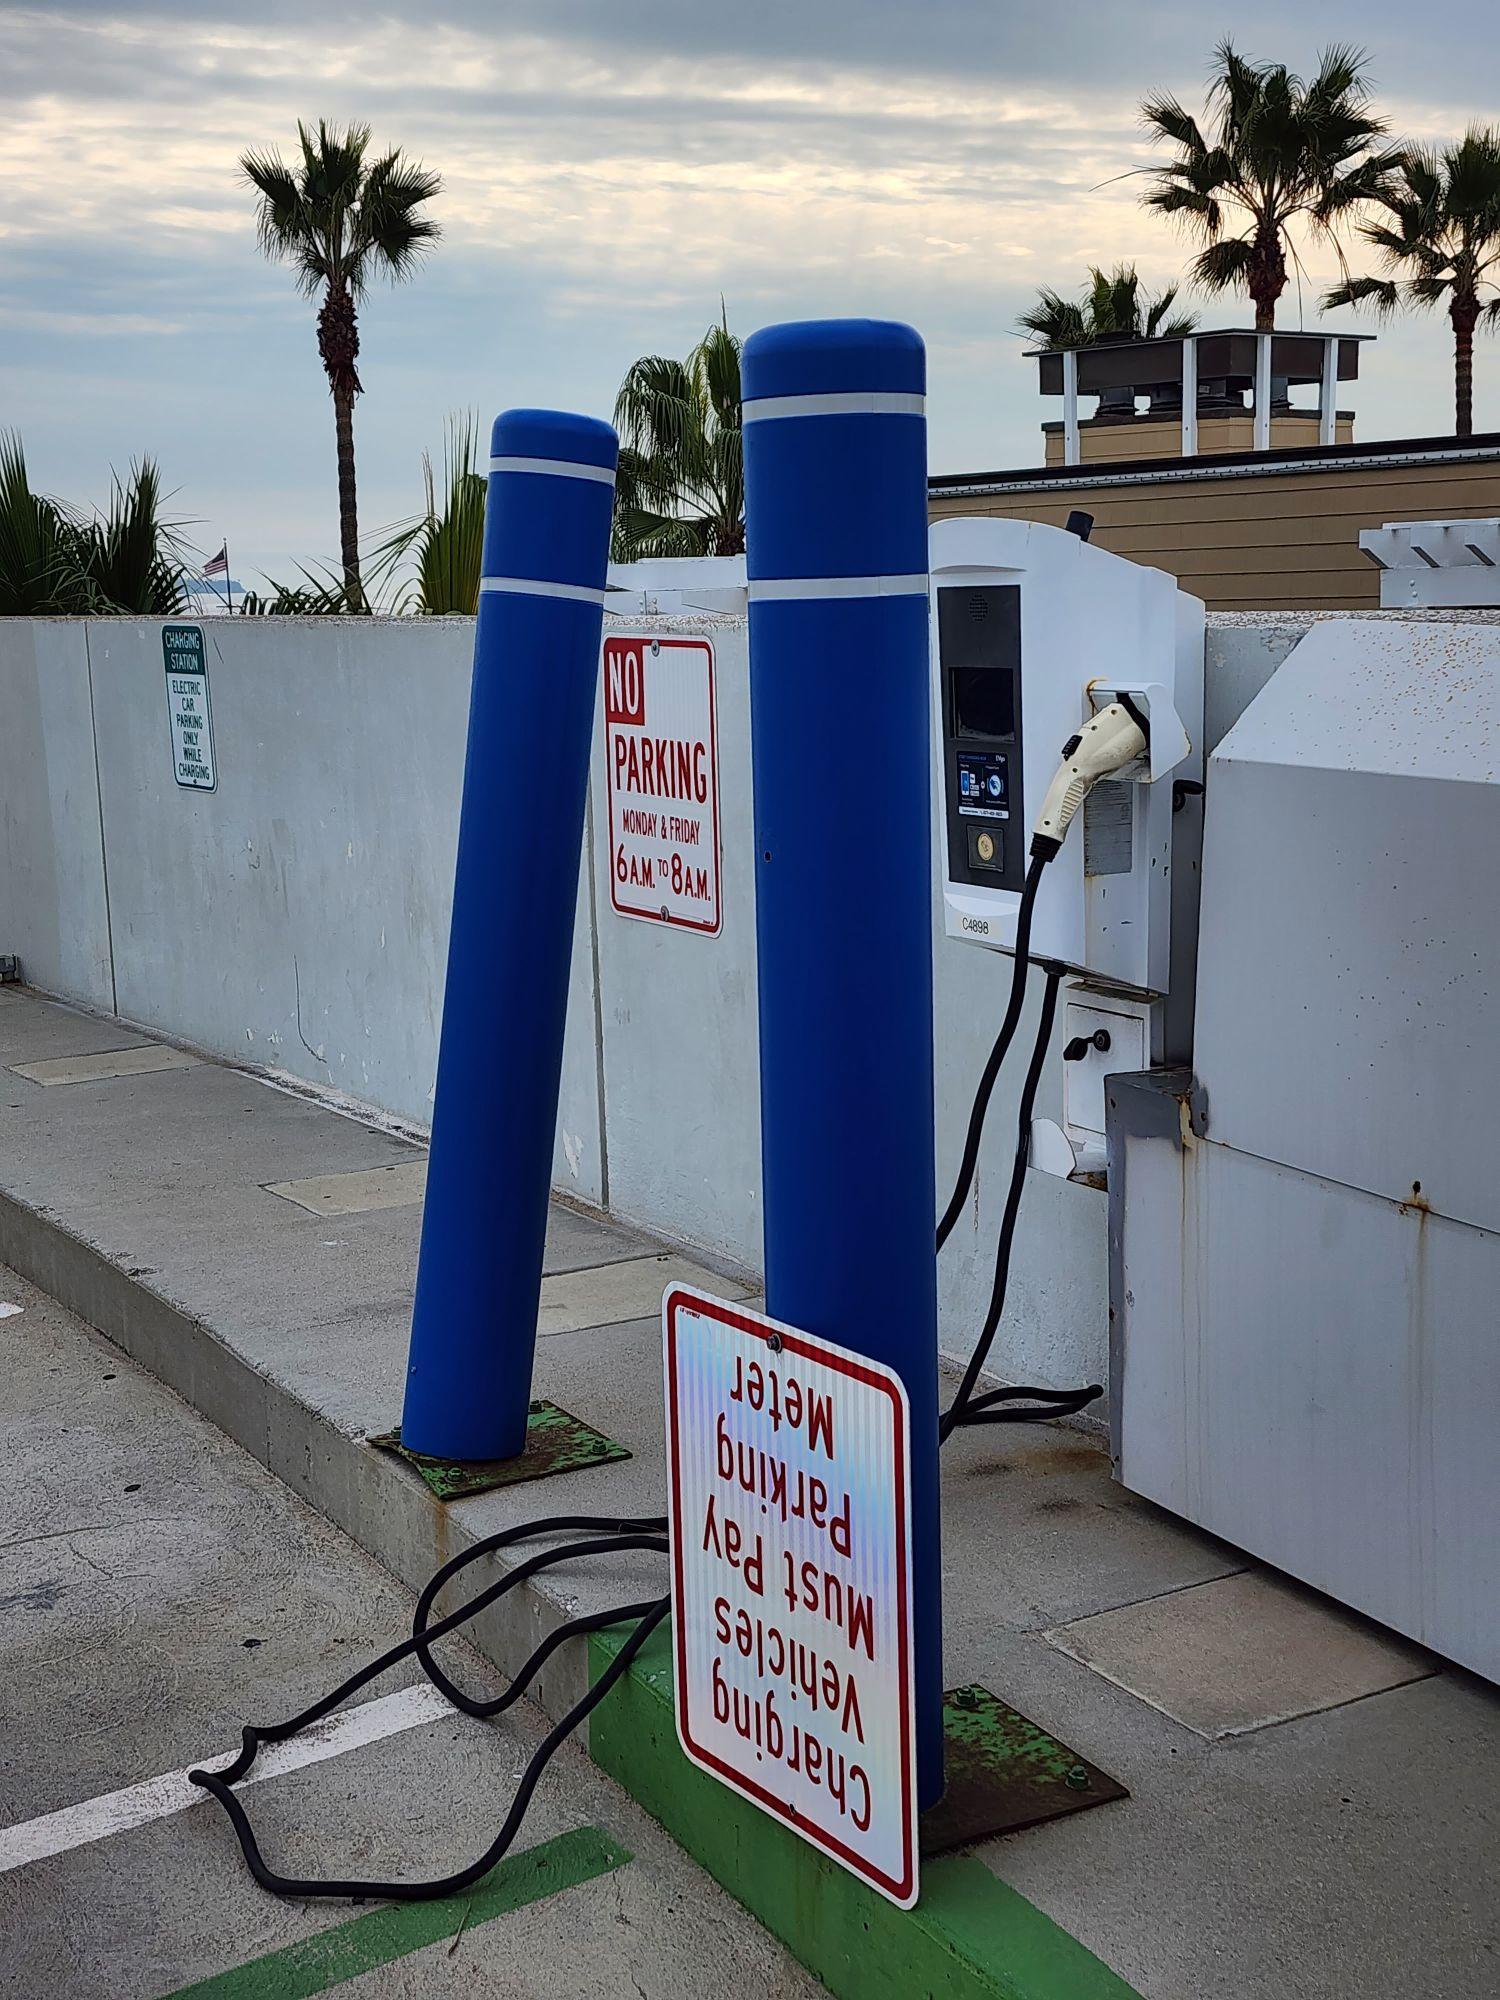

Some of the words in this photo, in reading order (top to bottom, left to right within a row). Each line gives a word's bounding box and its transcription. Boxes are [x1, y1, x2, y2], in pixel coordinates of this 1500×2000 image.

[165, 632, 200, 649] CHARGING
[171, 653, 199, 671] STATION
[172, 680, 201, 695] ELECTRIC
[608, 651, 639, 715] NO
[182, 698, 194, 712] CAR
[176, 714, 203, 729] PARKING
[183, 731, 198, 745] ONLY
[183, 747, 202, 763] WHILE
[178, 762, 209, 780] CHARGING
[615, 734, 707, 804] PARKING
[622, 808, 657, 838] MONDAY
[661, 814, 667, 840] &
[669, 816, 700, 845] FRIDAY
[657, 858, 668, 877] TO
[962, 917, 989, 934] C4898
[730, 1356, 834, 1460] Meter
[717, 1412, 852, 1559] Parking
[703, 1494, 764, 1596] Pay
[784, 1551, 874, 1661] Must
[714, 1597, 865, 1744] Vehicles
[712, 1657, 871, 1832] Charging
